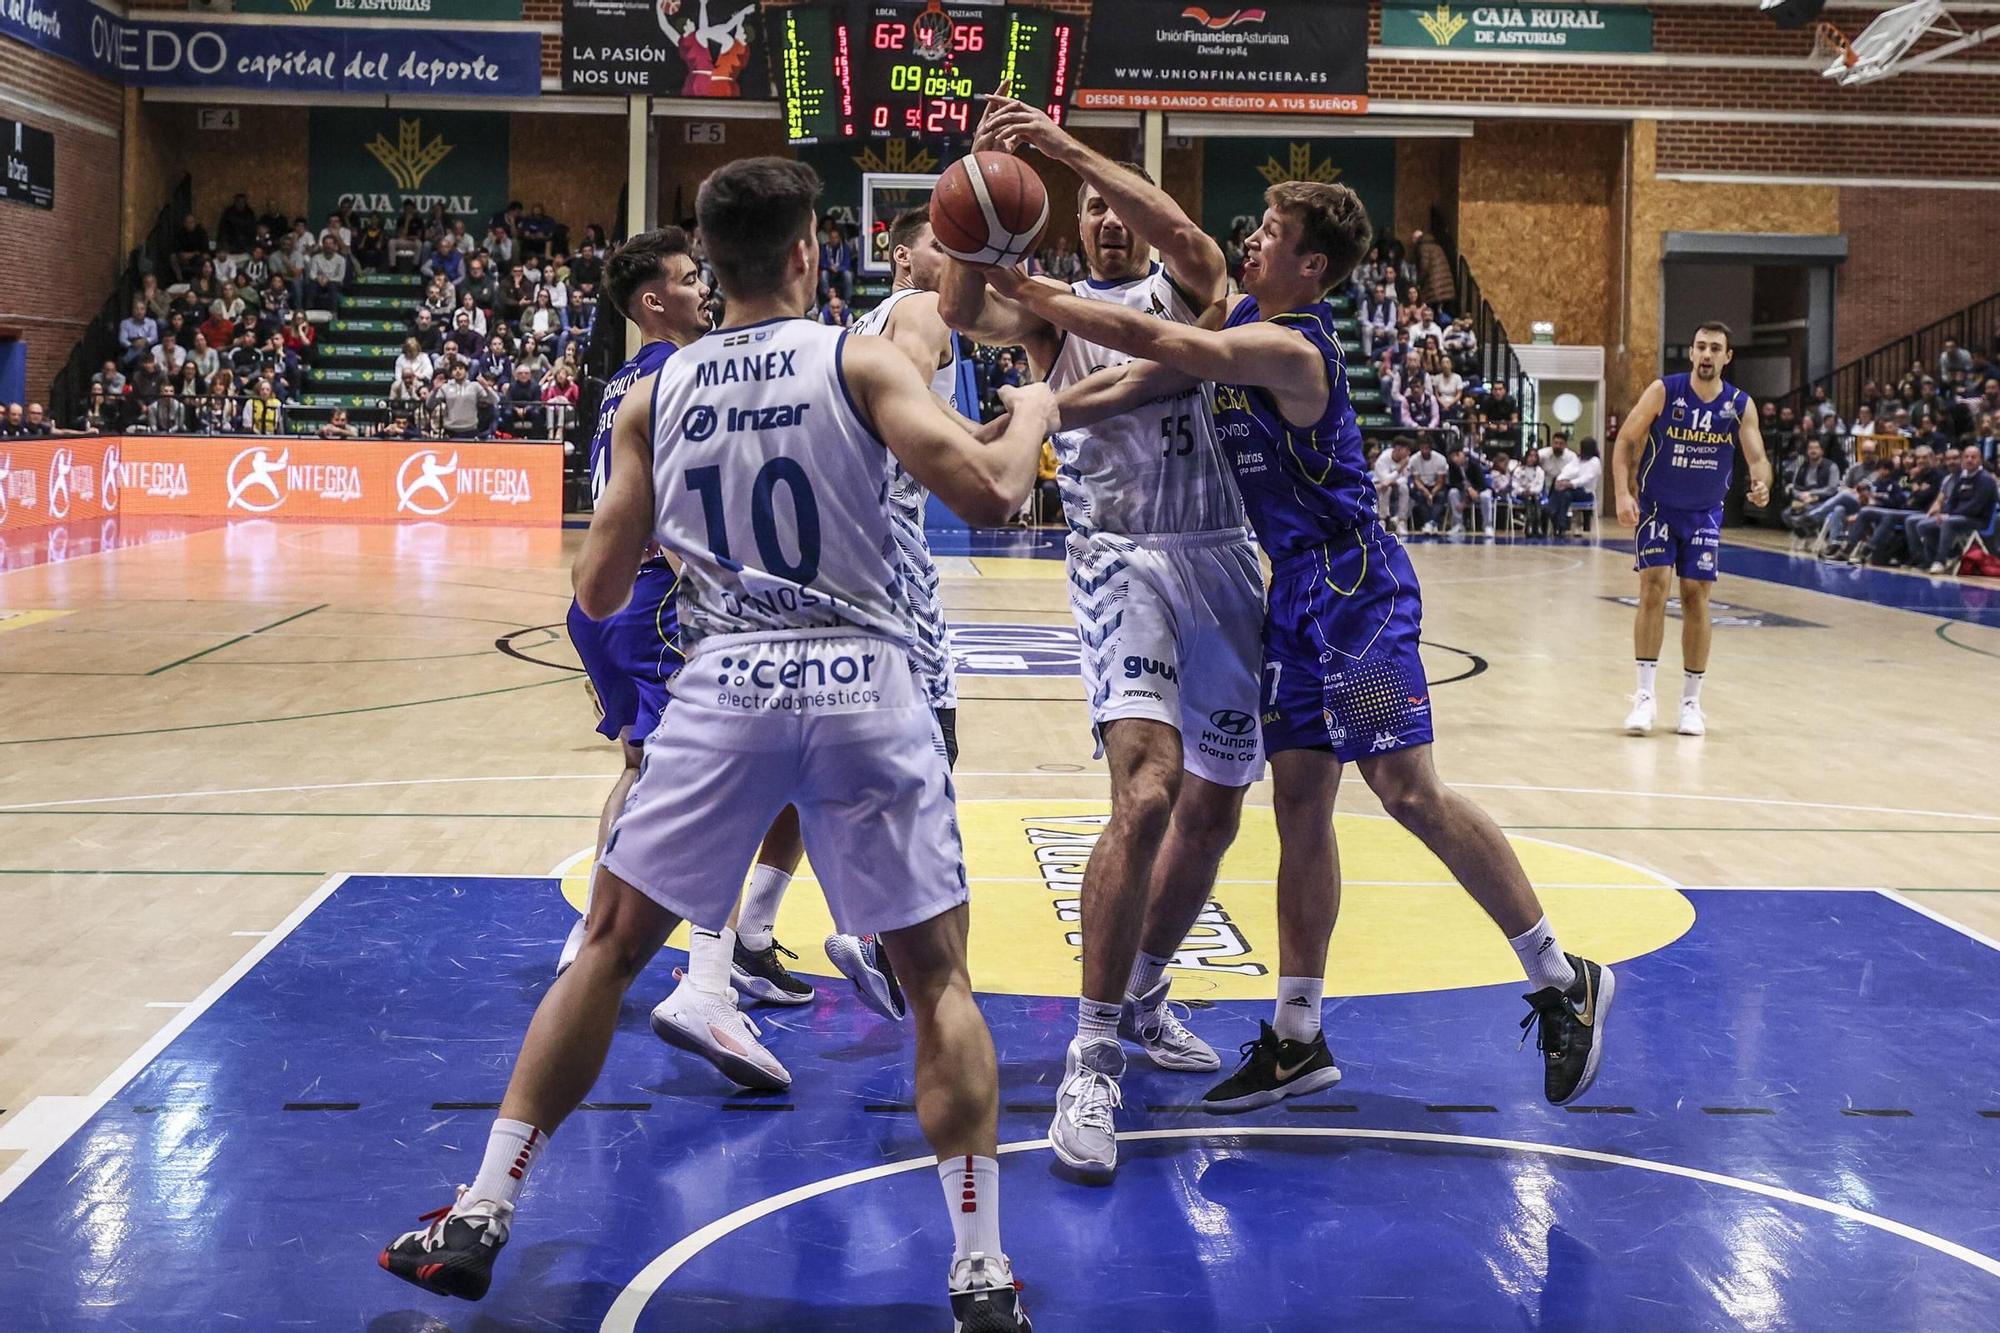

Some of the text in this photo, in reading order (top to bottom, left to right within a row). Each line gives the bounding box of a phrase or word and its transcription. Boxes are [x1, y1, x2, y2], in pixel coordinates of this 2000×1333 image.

[1472, 7, 1604, 29] CAJA RURAL
[91, 15, 227, 74] OVIEDO
[875, 23, 906, 49] 62
[920, 27, 932, 46] 4
[953, 25, 983, 51] 56
[1156, 29, 1289, 45] UniónFinancieraAsturiana
[1475, 31, 1566, 45] DE ASTURIAS
[573, 44, 666, 62] LA PASIÓN
[1197, 45, 1248, 57] Desde 1984
[237, 50, 499, 86] capital del deporte
[573, 70, 649, 85] NOS UNE
[891, 65, 922, 91] 09
[1115, 67, 1328, 83] WWW.UNIONFINANCIERA.ES
[924, 77, 972, 97] 09:40
[1086, 93, 1358, 111] DESDE 1984 DANDO CRÉDITO A TUS SUEÑOS
[202, 111, 234, 126] F 4
[874, 106, 888, 128] 0
[927, 100, 968, 132] 24
[689, 125, 721, 142] F 5
[695, 349, 798, 389] MANEX
[1691, 408, 1713, 431] 14
[1160, 414, 1195, 458] 55
[1666, 426, 1733, 444] ALIMERKA
[1686, 445, 1718, 454] OVIEDO
[119, 462, 188, 489] NTEGRA
[287, 465, 361, 492] INTEGRA
[457, 468, 530, 496] INTEGRA
[684, 456, 821, 587] 10
[1648, 520, 1669, 542] 14
[752, 653, 875, 689] cenor
[1123, 655, 1178, 685] guu
[1266, 661, 1283, 706] 7
[717, 687, 881, 711] electrodomésticos
[1201, 730, 1258, 749] HYUNDAI
[1198, 742, 1235, 761] Oarso
